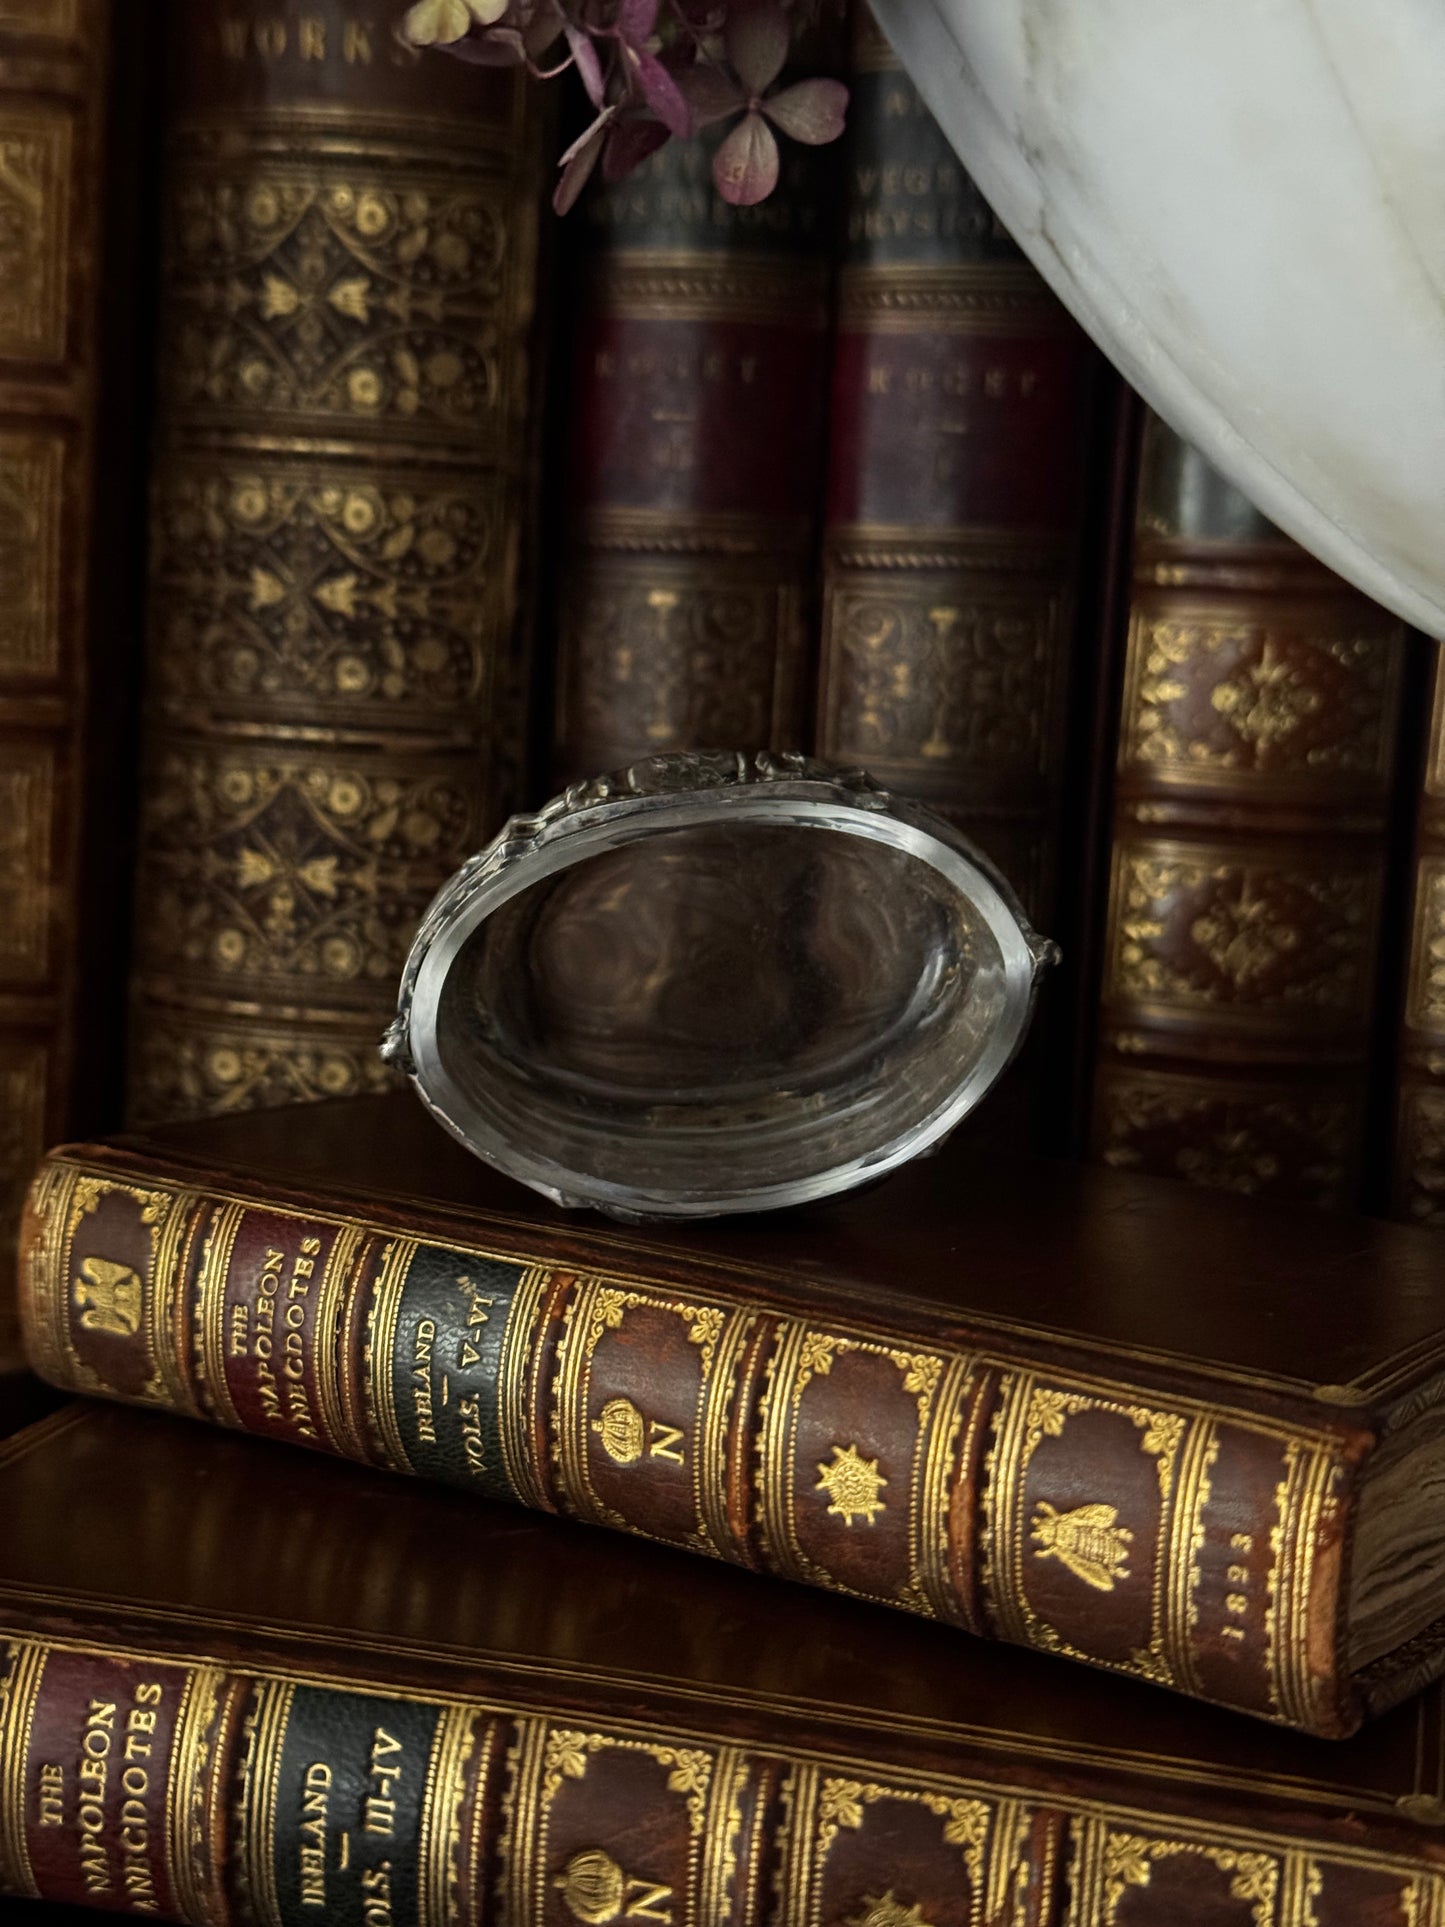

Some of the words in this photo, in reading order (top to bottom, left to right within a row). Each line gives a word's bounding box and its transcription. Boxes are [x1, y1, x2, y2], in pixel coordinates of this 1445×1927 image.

[230, 1304, 249, 1356] THE
[253, 1248, 286, 1421] NAPOLEON
[283, 1237, 322, 1439] ANECDOTES
[459, 1290, 493, 1370] V-VI
[412, 1319, 436, 1443] IRELAND
[459, 1392, 487, 1475] VOLS.
[649, 1420, 685, 1466] N
[40, 1763, 65, 1828] THE
[78, 1698, 118, 1895] NAPOLEON
[120, 1682, 164, 1912] ANECDOTES
[365, 1726, 403, 1837] III-IV
[301, 1761, 333, 1907] IRELAND
[361, 1860, 392, 1927] OLS.
[625, 1875, 673, 1925] N
